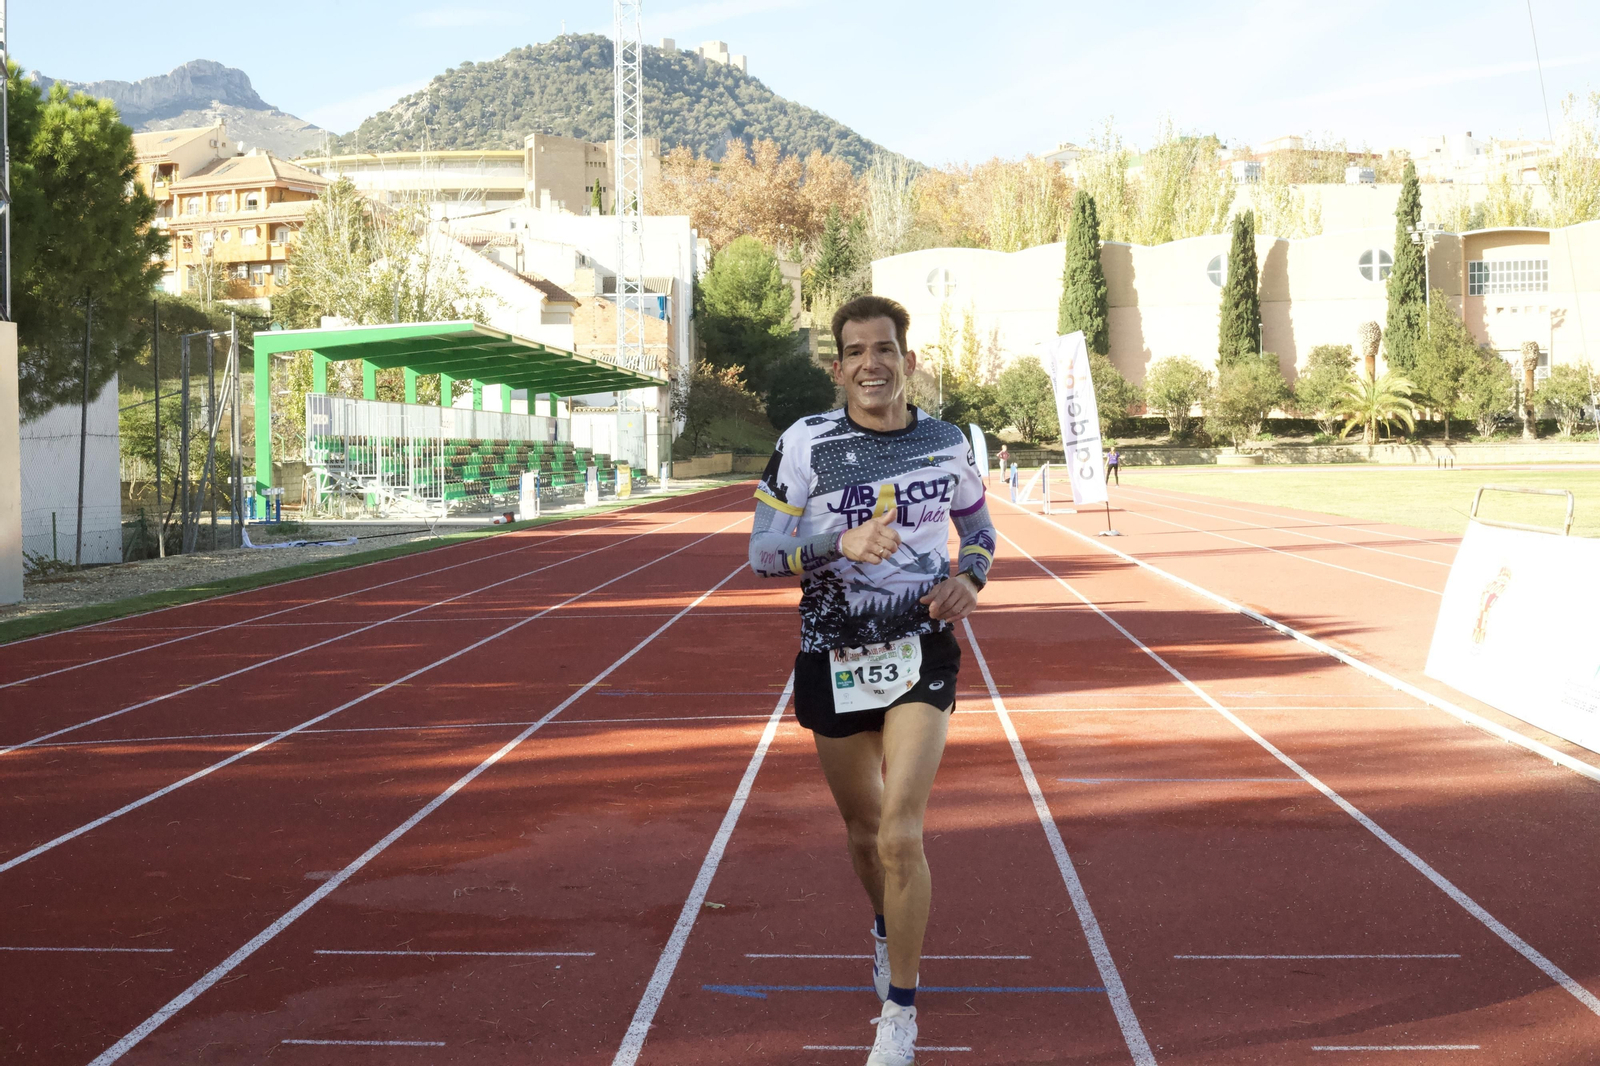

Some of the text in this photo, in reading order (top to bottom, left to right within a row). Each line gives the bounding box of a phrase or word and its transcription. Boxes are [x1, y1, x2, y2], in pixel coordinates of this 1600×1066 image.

[827, 480, 951, 513] JABALCUZ
[913, 505, 946, 533] Jaén
[855, 664, 899, 684] 153
